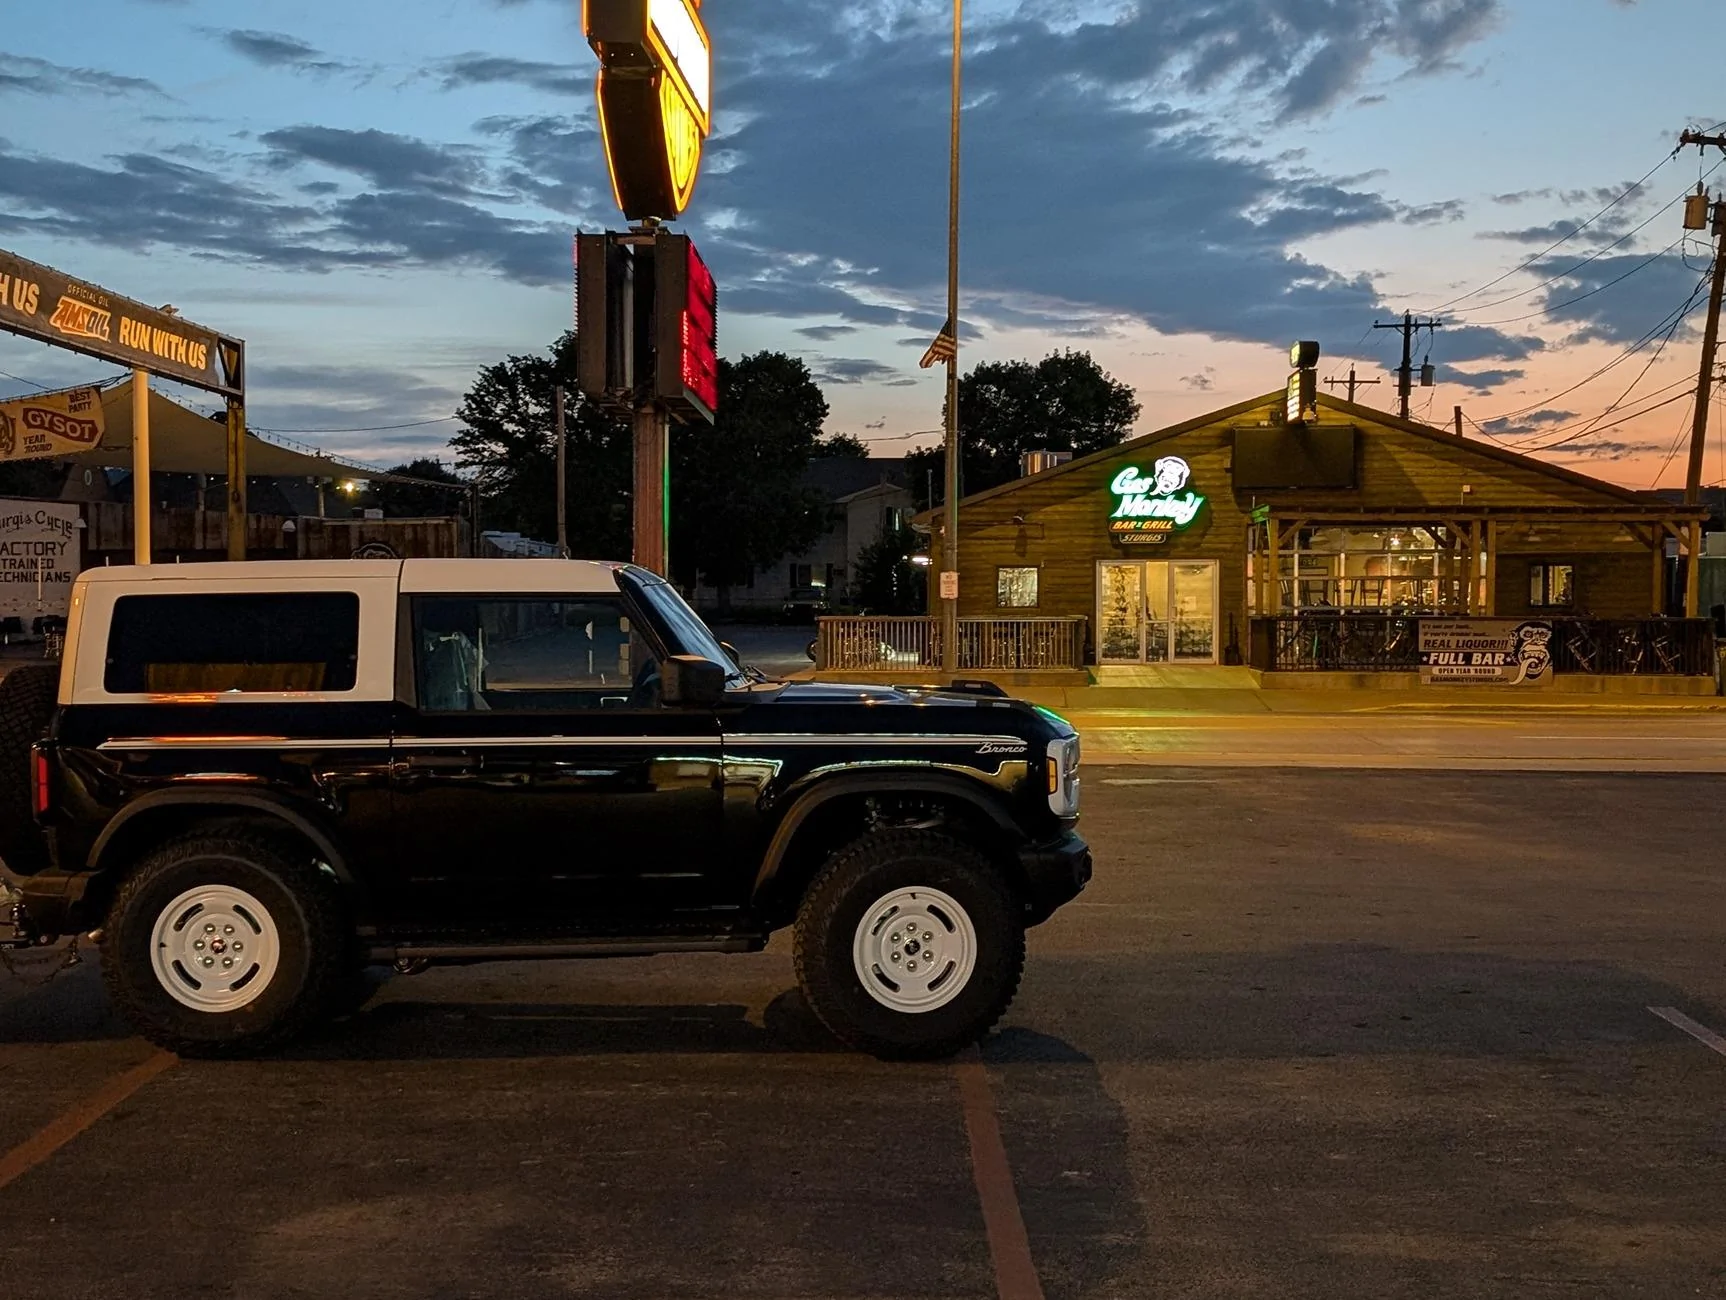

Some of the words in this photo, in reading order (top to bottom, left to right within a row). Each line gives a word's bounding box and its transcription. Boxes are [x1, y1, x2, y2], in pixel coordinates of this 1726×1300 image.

[13, 278, 40, 315] US
[67, 284, 97, 302] OFFICIAL
[98, 296, 109, 307] OIL
[51, 298, 110, 340] AMSOIL
[119, 316, 152, 353] RUN
[152, 328, 188, 364] WITH
[188, 341, 207, 371] US
[69, 391, 91, 403] BEST
[68, 401, 92, 414] PARTY
[27, 410, 92, 439] GYSOT
[23, 434, 46, 446] YEAR
[1112, 520, 1137, 530] BAR
[1142, 520, 1173, 530] GRILL
[1123, 534, 1162, 542] STURGIS
[1, 558, 54, 570] TRAINED
[1424, 640, 1452, 648] REAL
[1456, 640, 1509, 649] LIQUOR!!!
[1429, 652, 1466, 665] FULL
[1471, 652, 1505, 665] BAR
[975, 741, 1028, 754] Bronco
